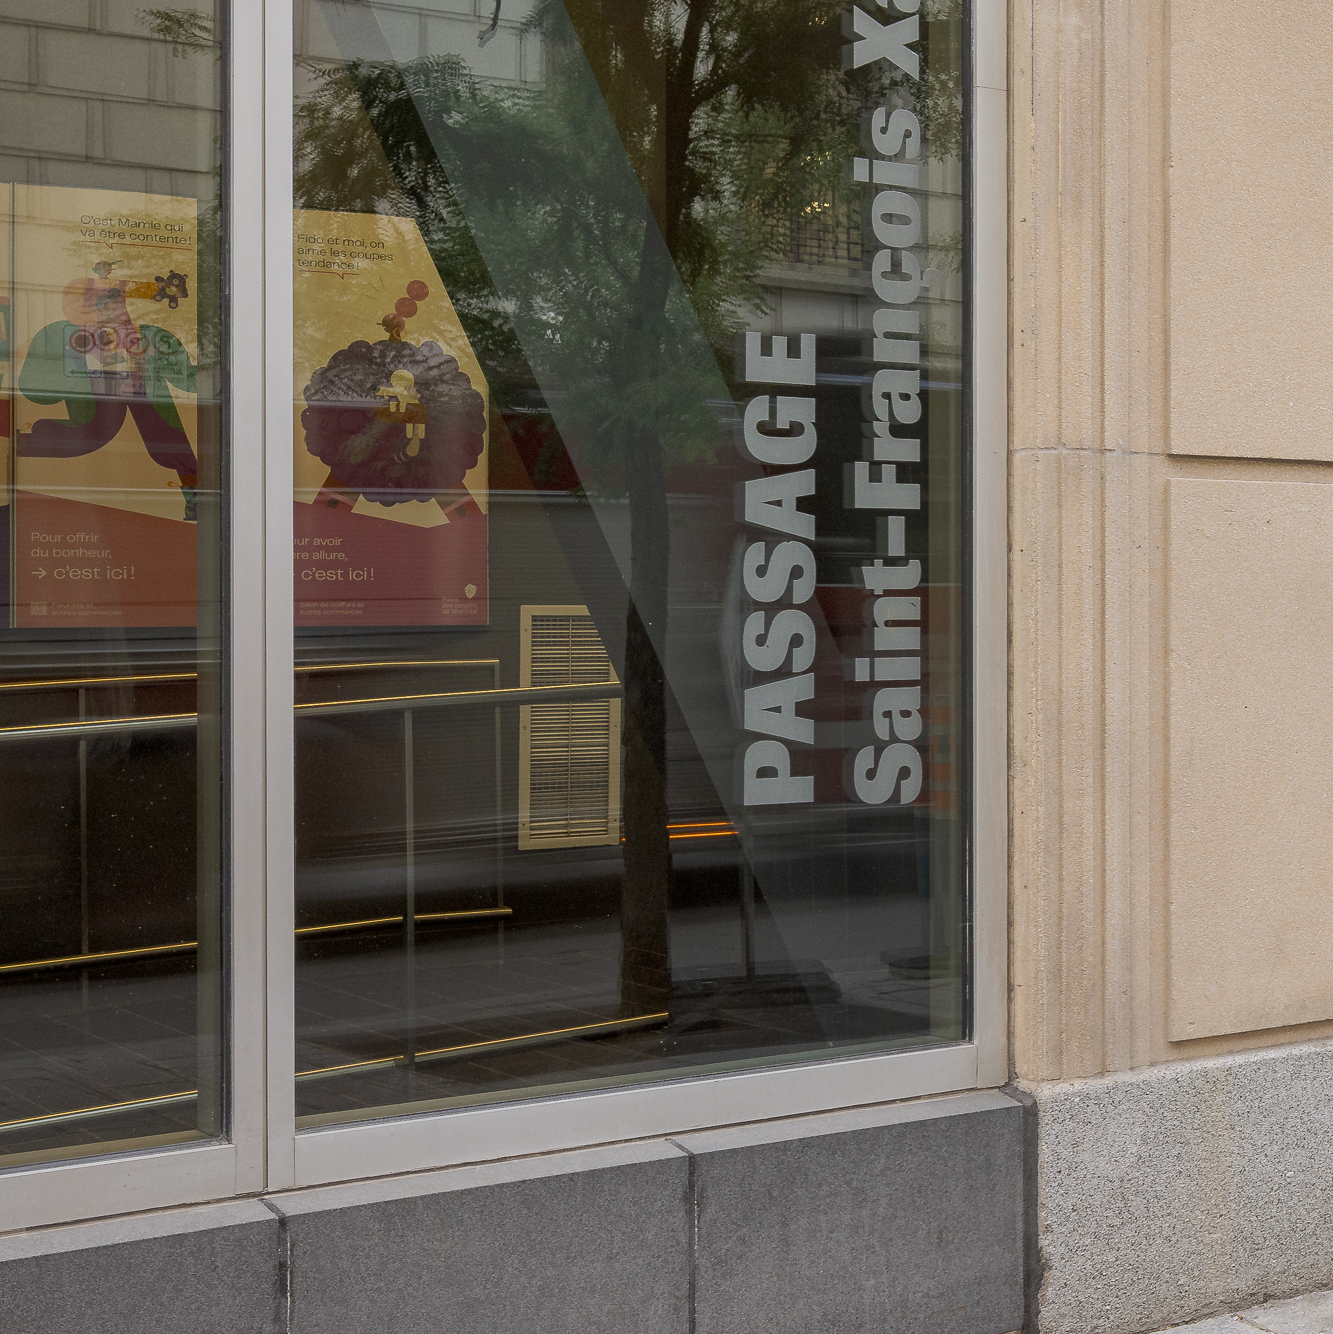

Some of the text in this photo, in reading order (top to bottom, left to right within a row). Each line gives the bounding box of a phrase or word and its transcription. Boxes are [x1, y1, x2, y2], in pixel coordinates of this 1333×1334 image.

[117, 218, 162, 231] Mamie
[164, 223, 184, 233] qui
[80, 229, 96, 238] va
[99, 229, 126, 240] être
[297, 234, 385, 249] Fido et moi, on
[297, 246, 394, 262] aime les coupes
[853, 107, 941, 804] Saint-François
[31, 532, 100, 543] Pour offrir
[313, 536, 343, 546] avoir
[30, 547, 112, 559] du bonheur,
[312, 550, 348, 561] allure,
[743, 331, 816, 806] PASSAGE
